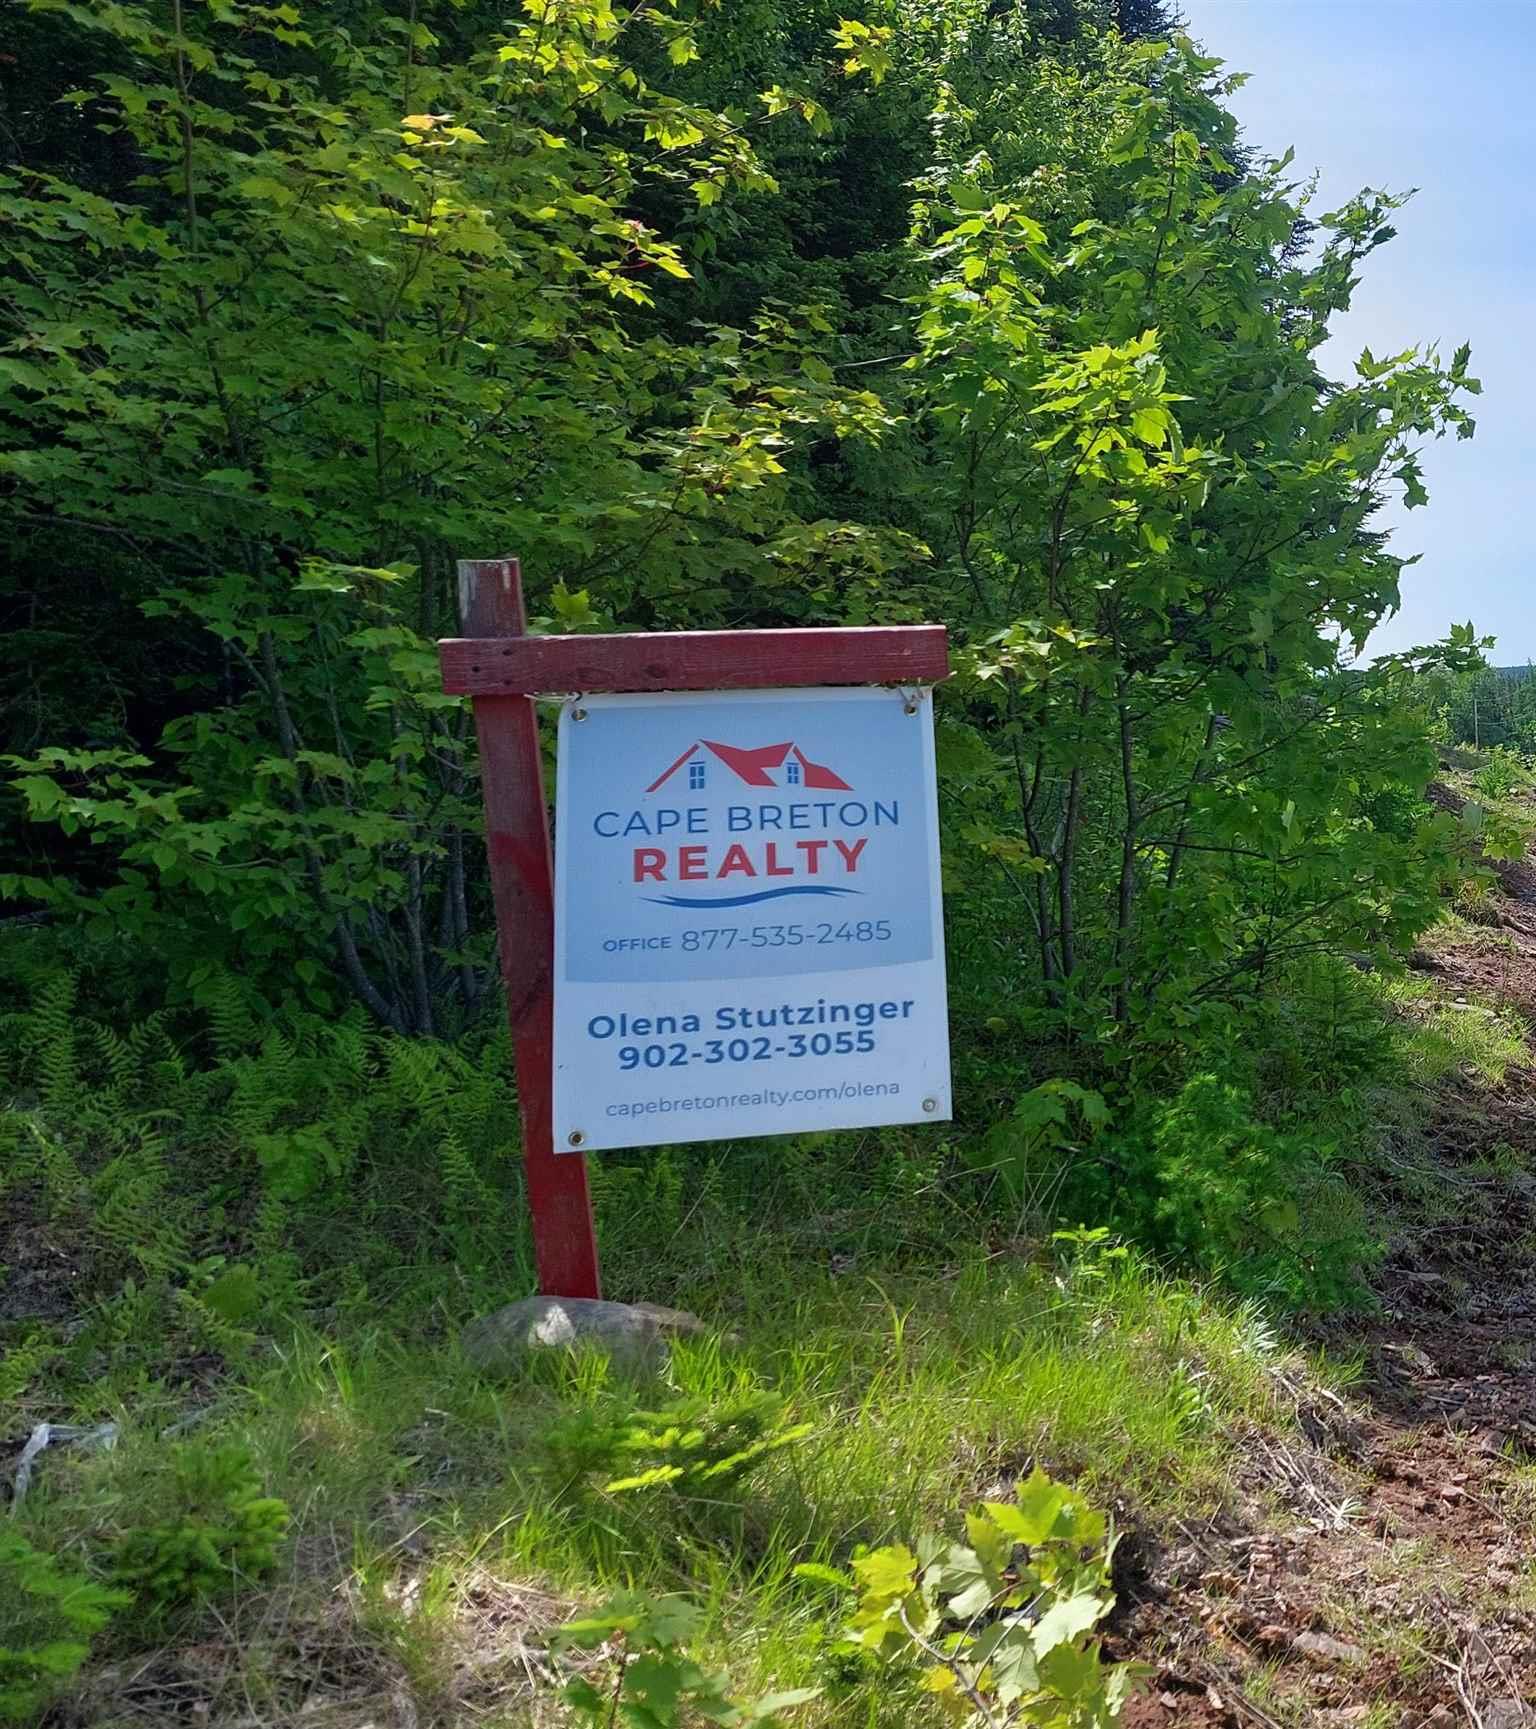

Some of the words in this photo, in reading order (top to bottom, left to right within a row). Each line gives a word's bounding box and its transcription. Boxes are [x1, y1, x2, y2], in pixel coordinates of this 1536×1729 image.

[593, 807, 708, 838] CAPE
[728, 800, 899, 832] BRETON
[633, 839, 868, 882] REALTY
[602, 936, 671, 953] OFFICE
[682, 920, 892, 952] 877-535-2485
[588, 1012, 701, 1039] Olena
[716, 997, 914, 1032] Stutzinger
[618, 1030, 875, 1071] 902-302-3055
[606, 1080, 900, 1119] capebretonrealty.com/olena
